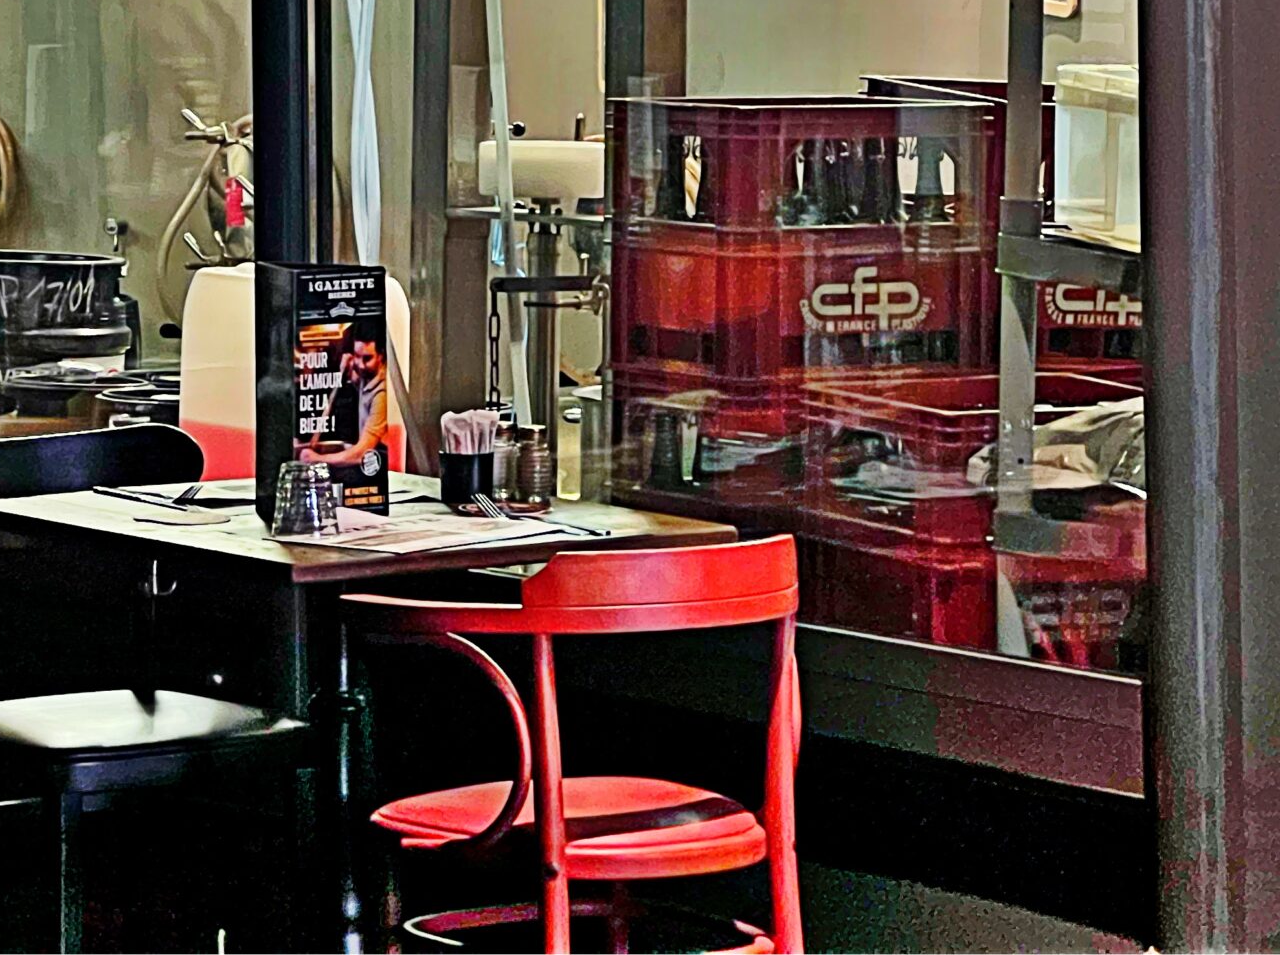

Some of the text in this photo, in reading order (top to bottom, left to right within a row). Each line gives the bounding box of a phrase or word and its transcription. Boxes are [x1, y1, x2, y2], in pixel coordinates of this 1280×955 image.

[314, 278, 375, 292] GAZETTE
[812, 266, 920, 331] cfp
[300, 351, 328, 369] POUR
[300, 372, 342, 390] L'AMOUR
[300, 394, 329, 412] DE LA
[300, 413, 329, 434] BIÈRE
